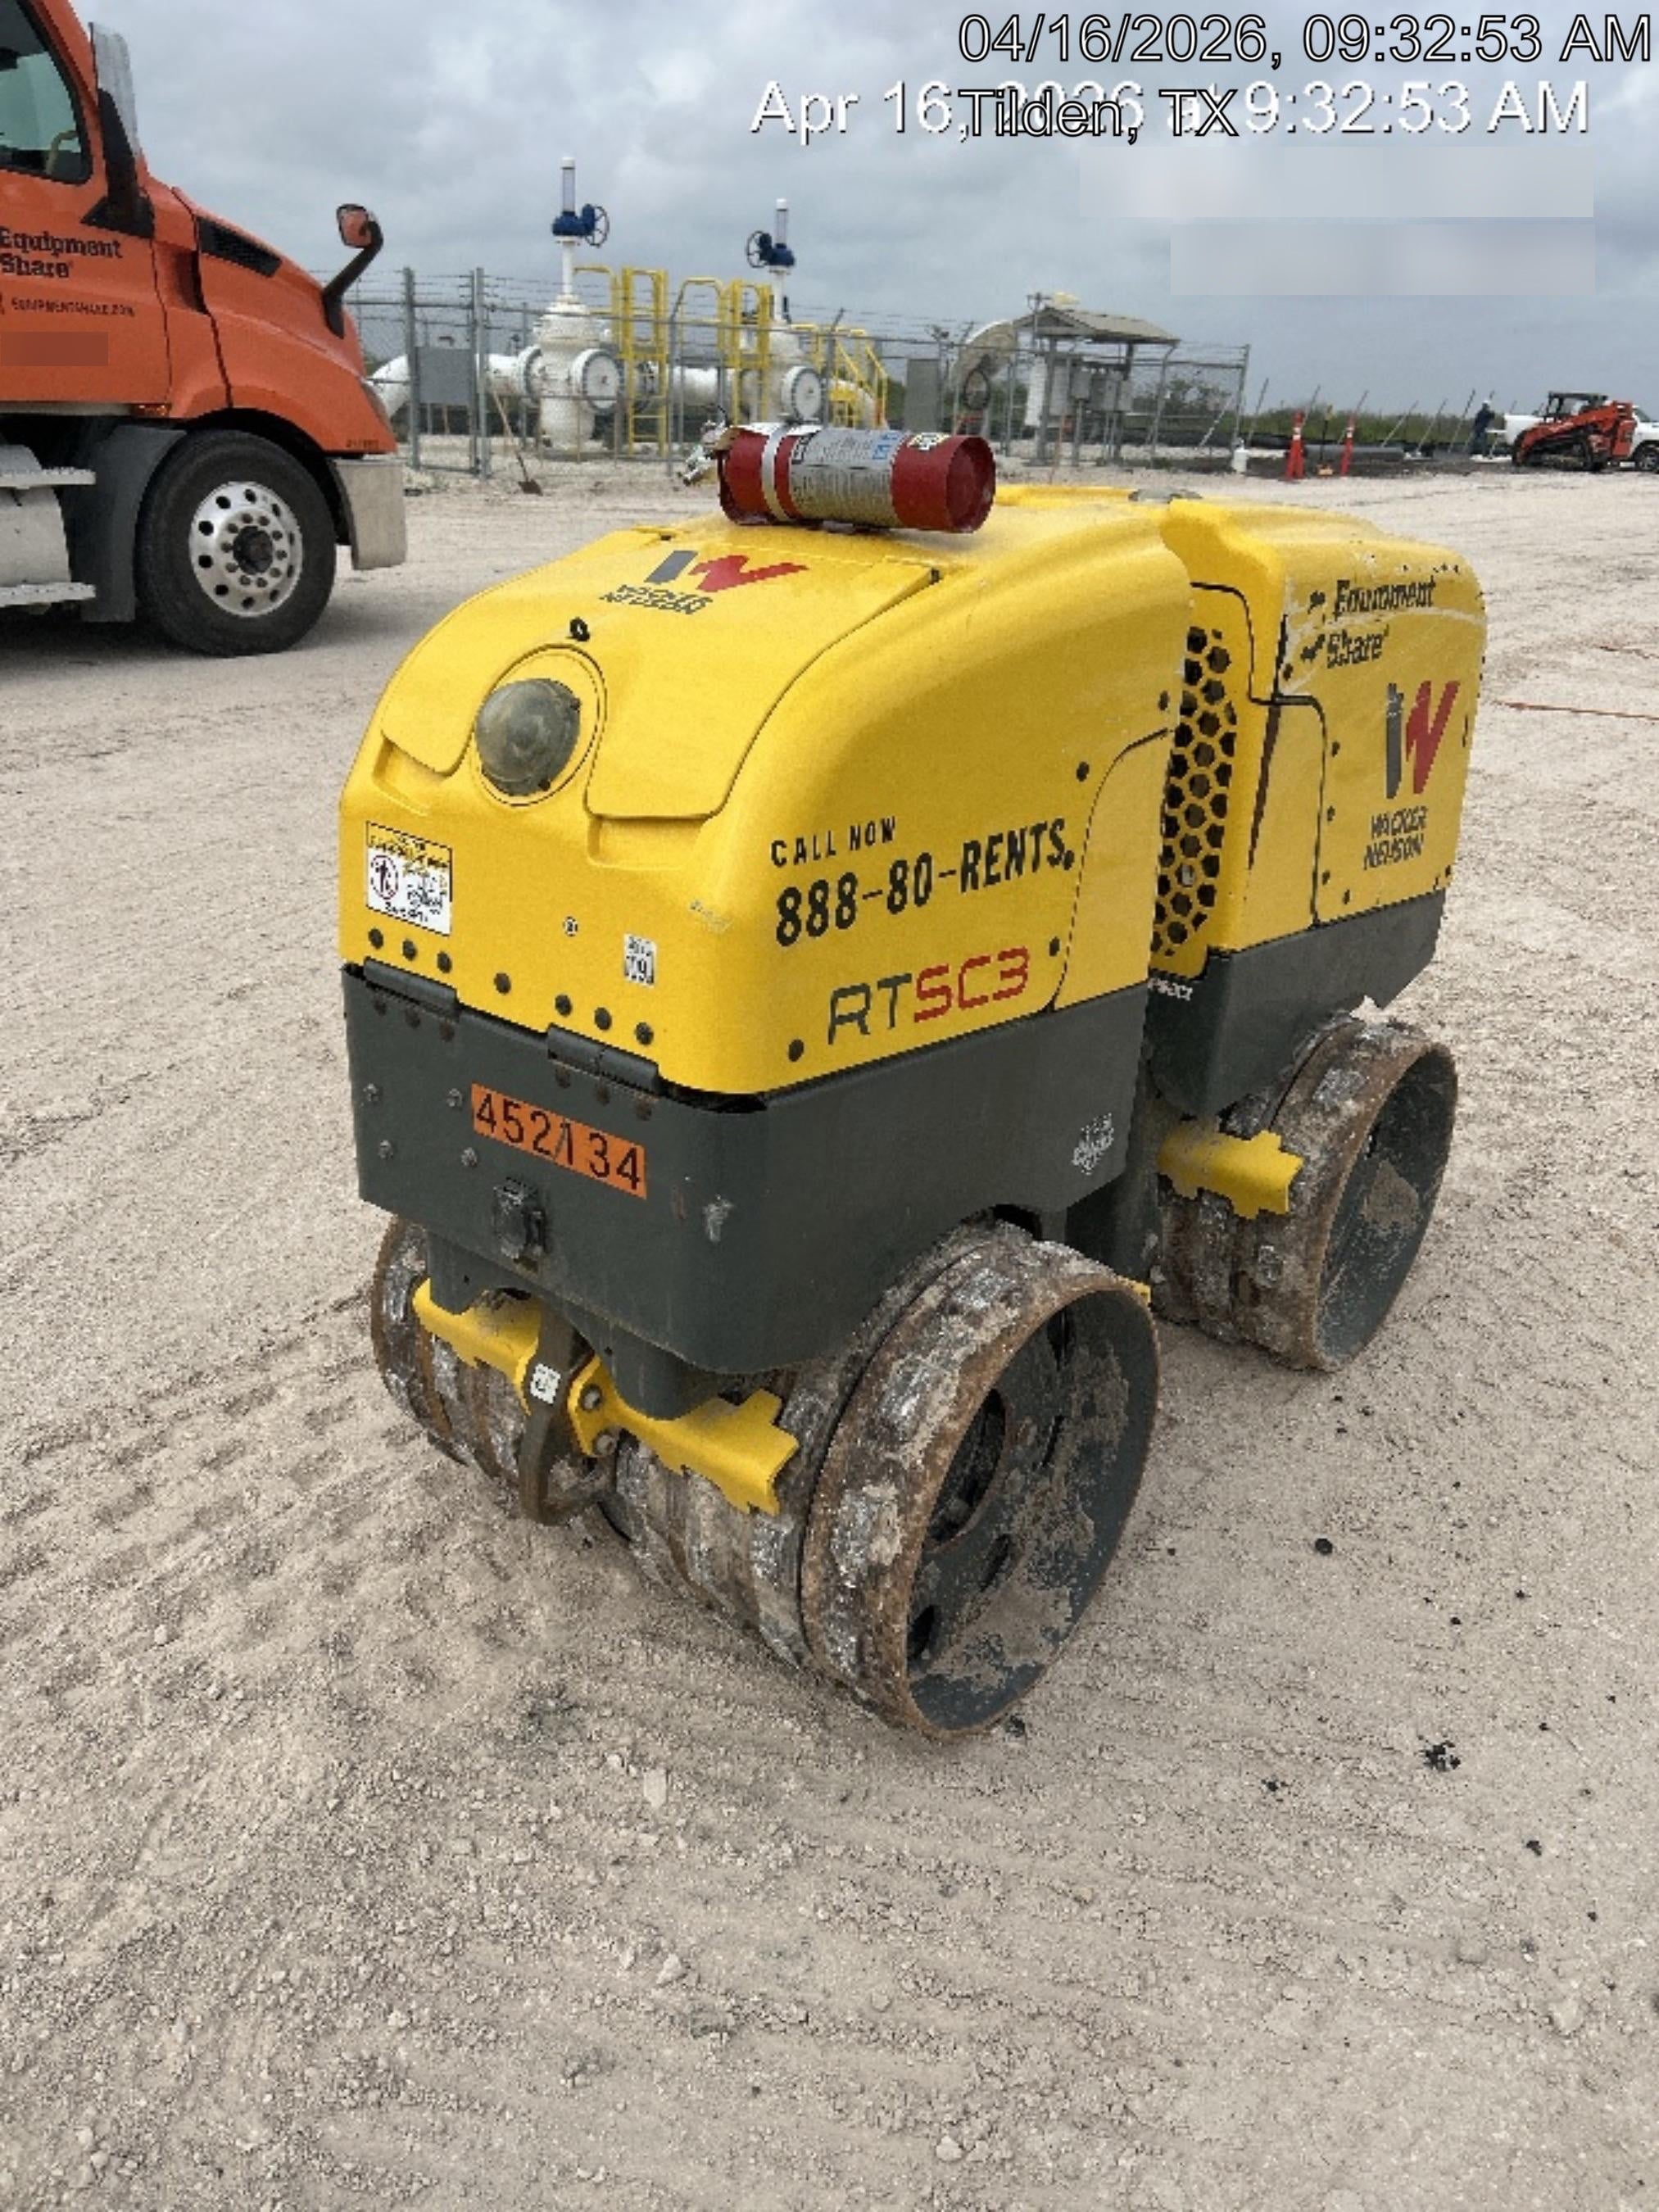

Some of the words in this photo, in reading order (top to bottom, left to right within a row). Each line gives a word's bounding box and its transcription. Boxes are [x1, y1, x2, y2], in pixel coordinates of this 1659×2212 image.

[0, 226, 123, 259] Equipment
[0, 252, 70, 279] Share
[1327, 629, 1384, 669] Share
[771, 830, 836, 868] CALL
[850, 815, 895, 851] NOW
[827, 945, 1030, 1045] RTSC3
